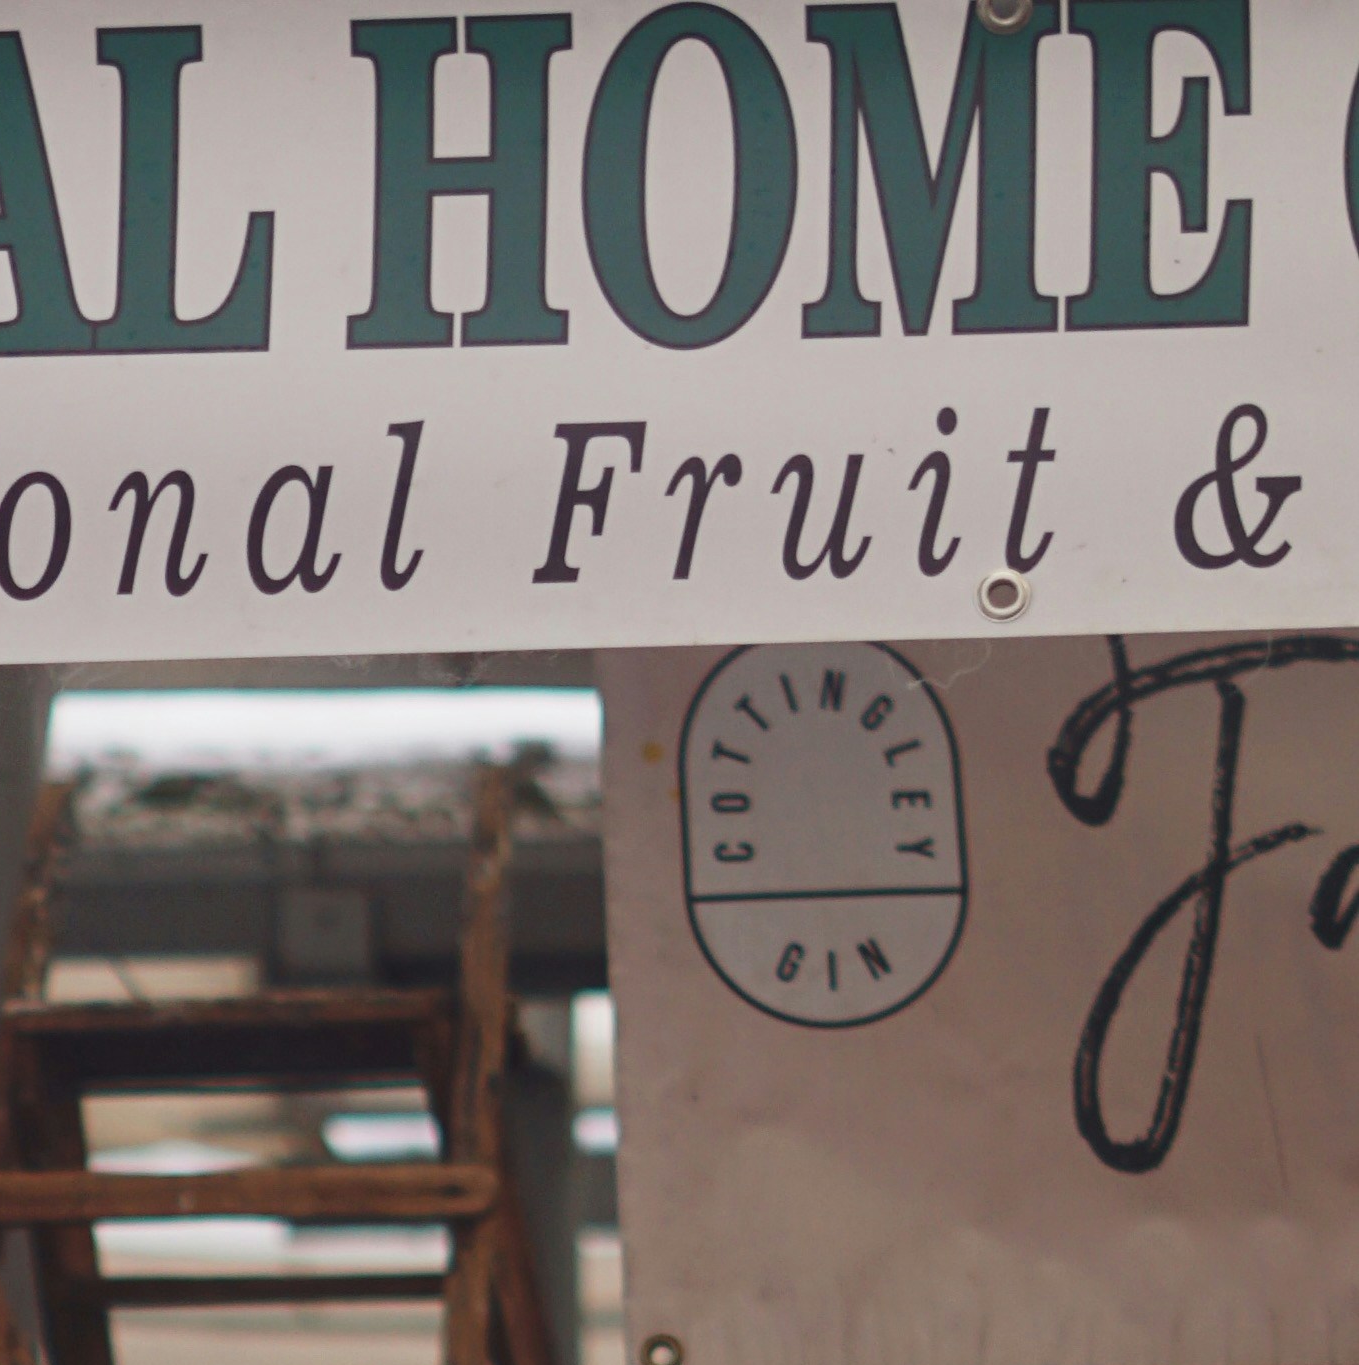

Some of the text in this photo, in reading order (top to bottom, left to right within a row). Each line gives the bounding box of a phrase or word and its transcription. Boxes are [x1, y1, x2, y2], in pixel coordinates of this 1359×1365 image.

[345, 0, 1252, 350] HOME
[532, 407, 1056, 584] Fruit
[1174, 403, 1303, 570] &
[711, 669, 936, 863] COTTINGLEY
[776, 938, 893, 991] GIN
